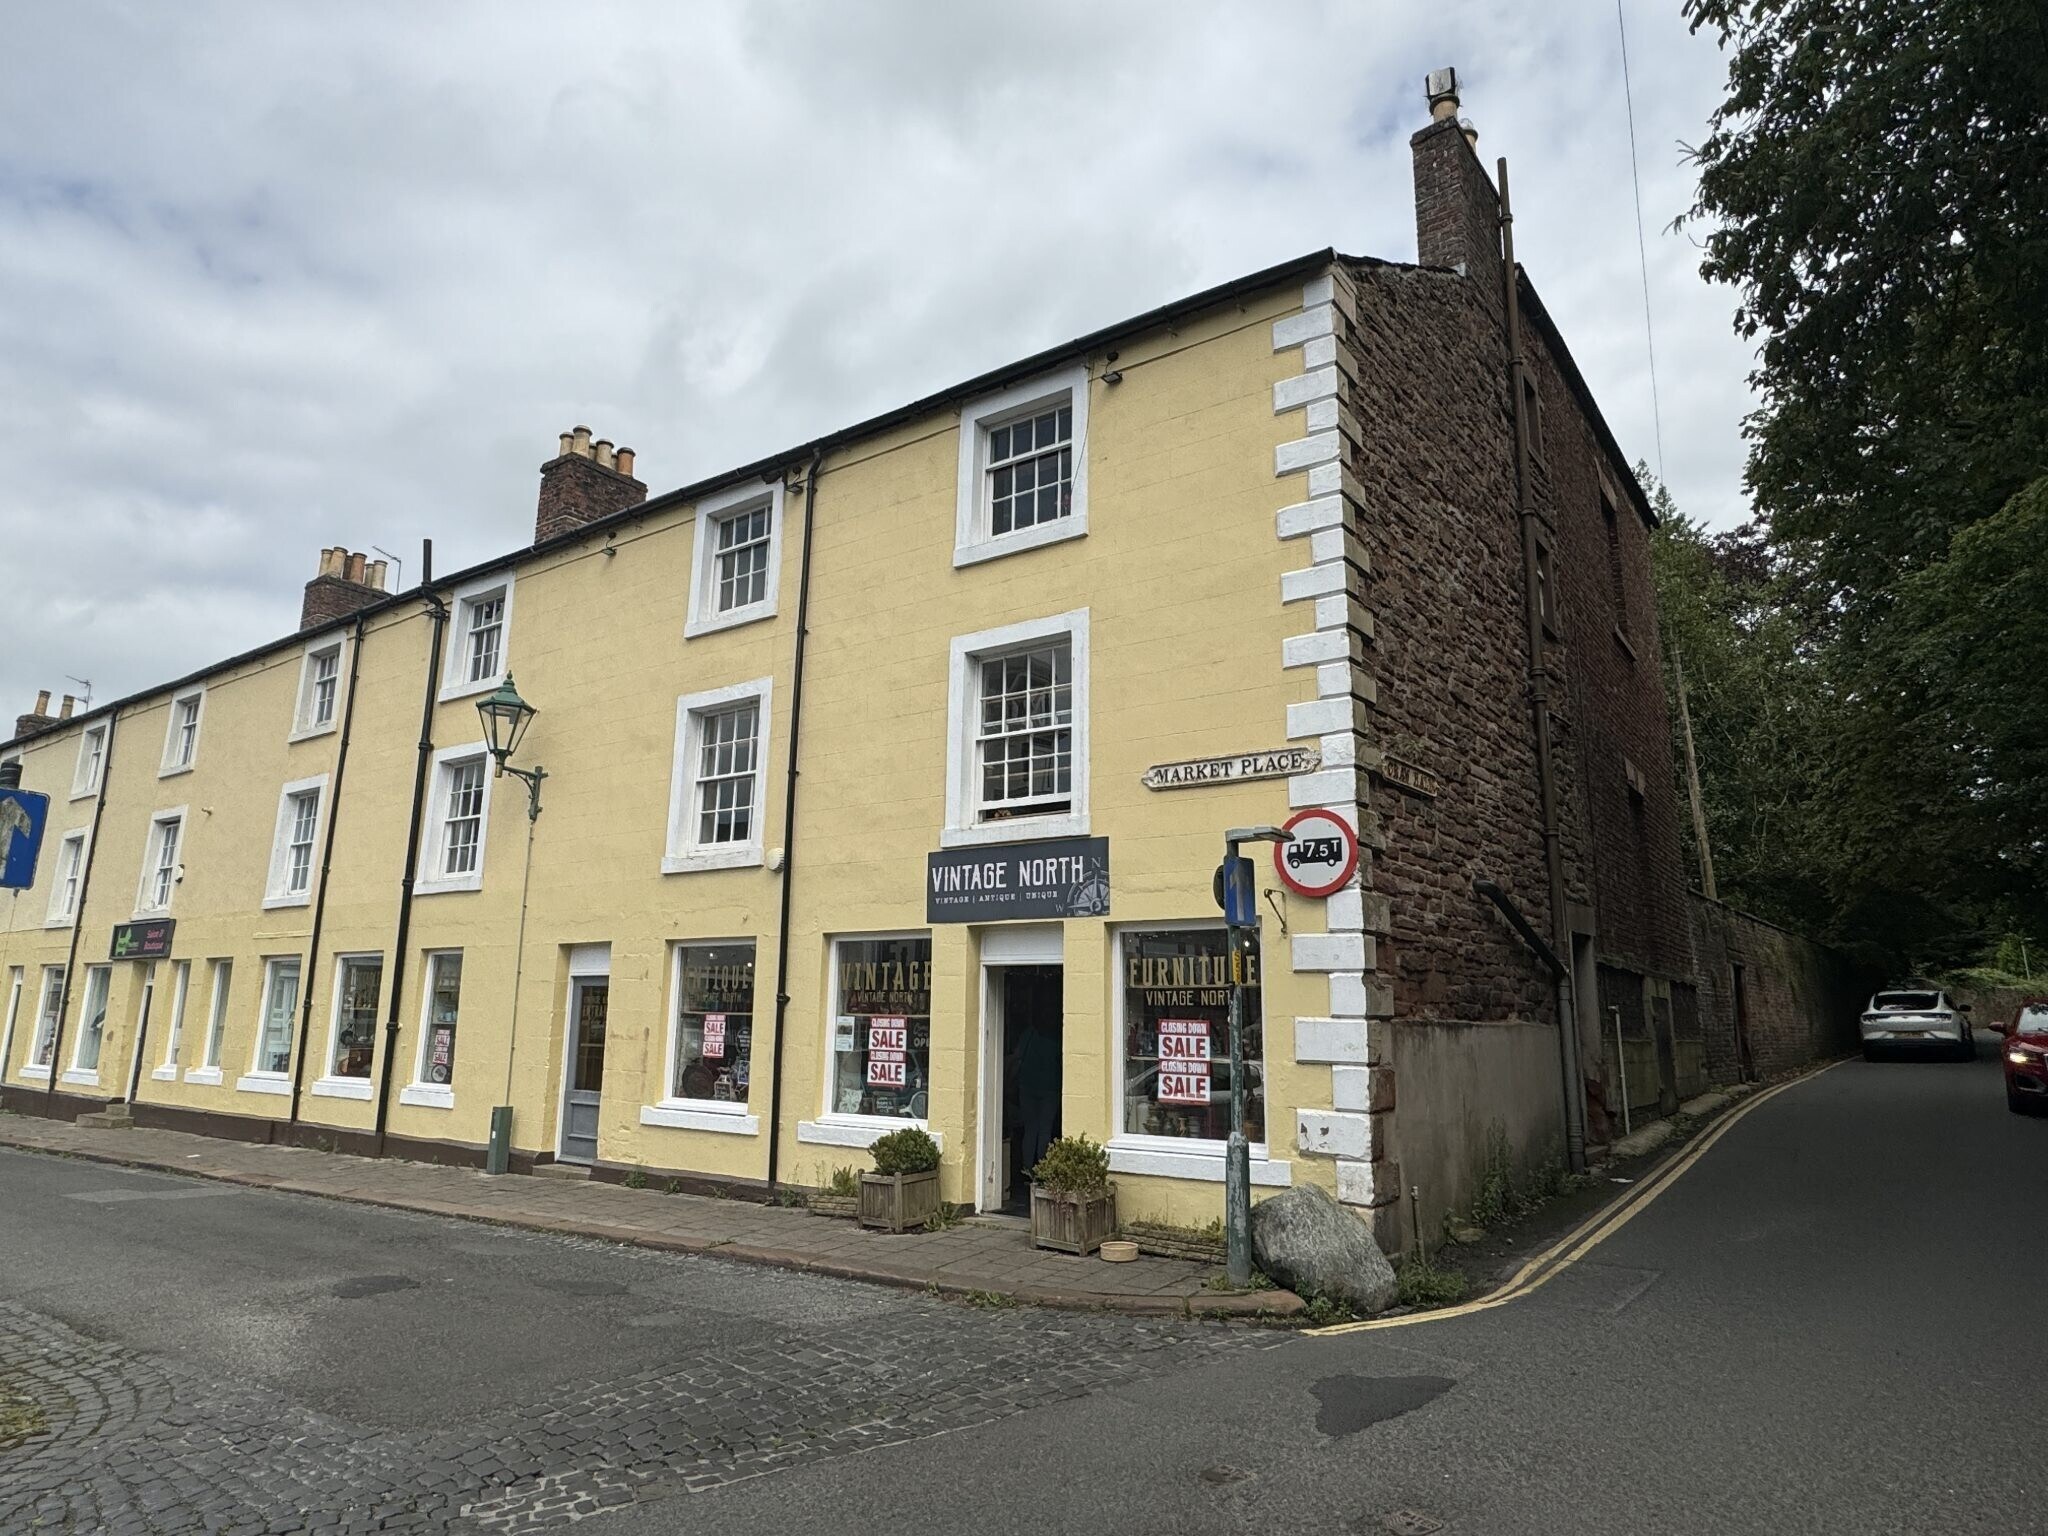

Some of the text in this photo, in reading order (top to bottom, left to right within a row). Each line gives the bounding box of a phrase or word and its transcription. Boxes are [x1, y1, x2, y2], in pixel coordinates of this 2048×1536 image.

[1156, 753, 1302, 785] MARKET PLACE
[1091, 857, 1101, 869] N
[932, 855, 1084, 892] VINTAGE NORTH
[935, 890, 1058, 905] VINTAGE ANTIQUE UNIQUE
[684, 964, 755, 993] ANTIQUE
[841, 961, 931, 991] VINTAGE
[1129, 955, 1257, 988] FURNITUE
[1145, 989, 1230, 1006] VINTAGE NORT
[706, 1022, 724, 1034] SALE
[1161, 1022, 1207, 1034] CLOSING DOWN
[704, 1042, 723, 1055] SALE
[872, 1031, 904, 1049] SALE
[1162, 1036, 1206, 1058] SALE
[870, 1063, 902, 1082] SALE
[1161, 1061, 1208, 1074] CLOSING DOWN
[1162, 1076, 1206, 1099] SALE
